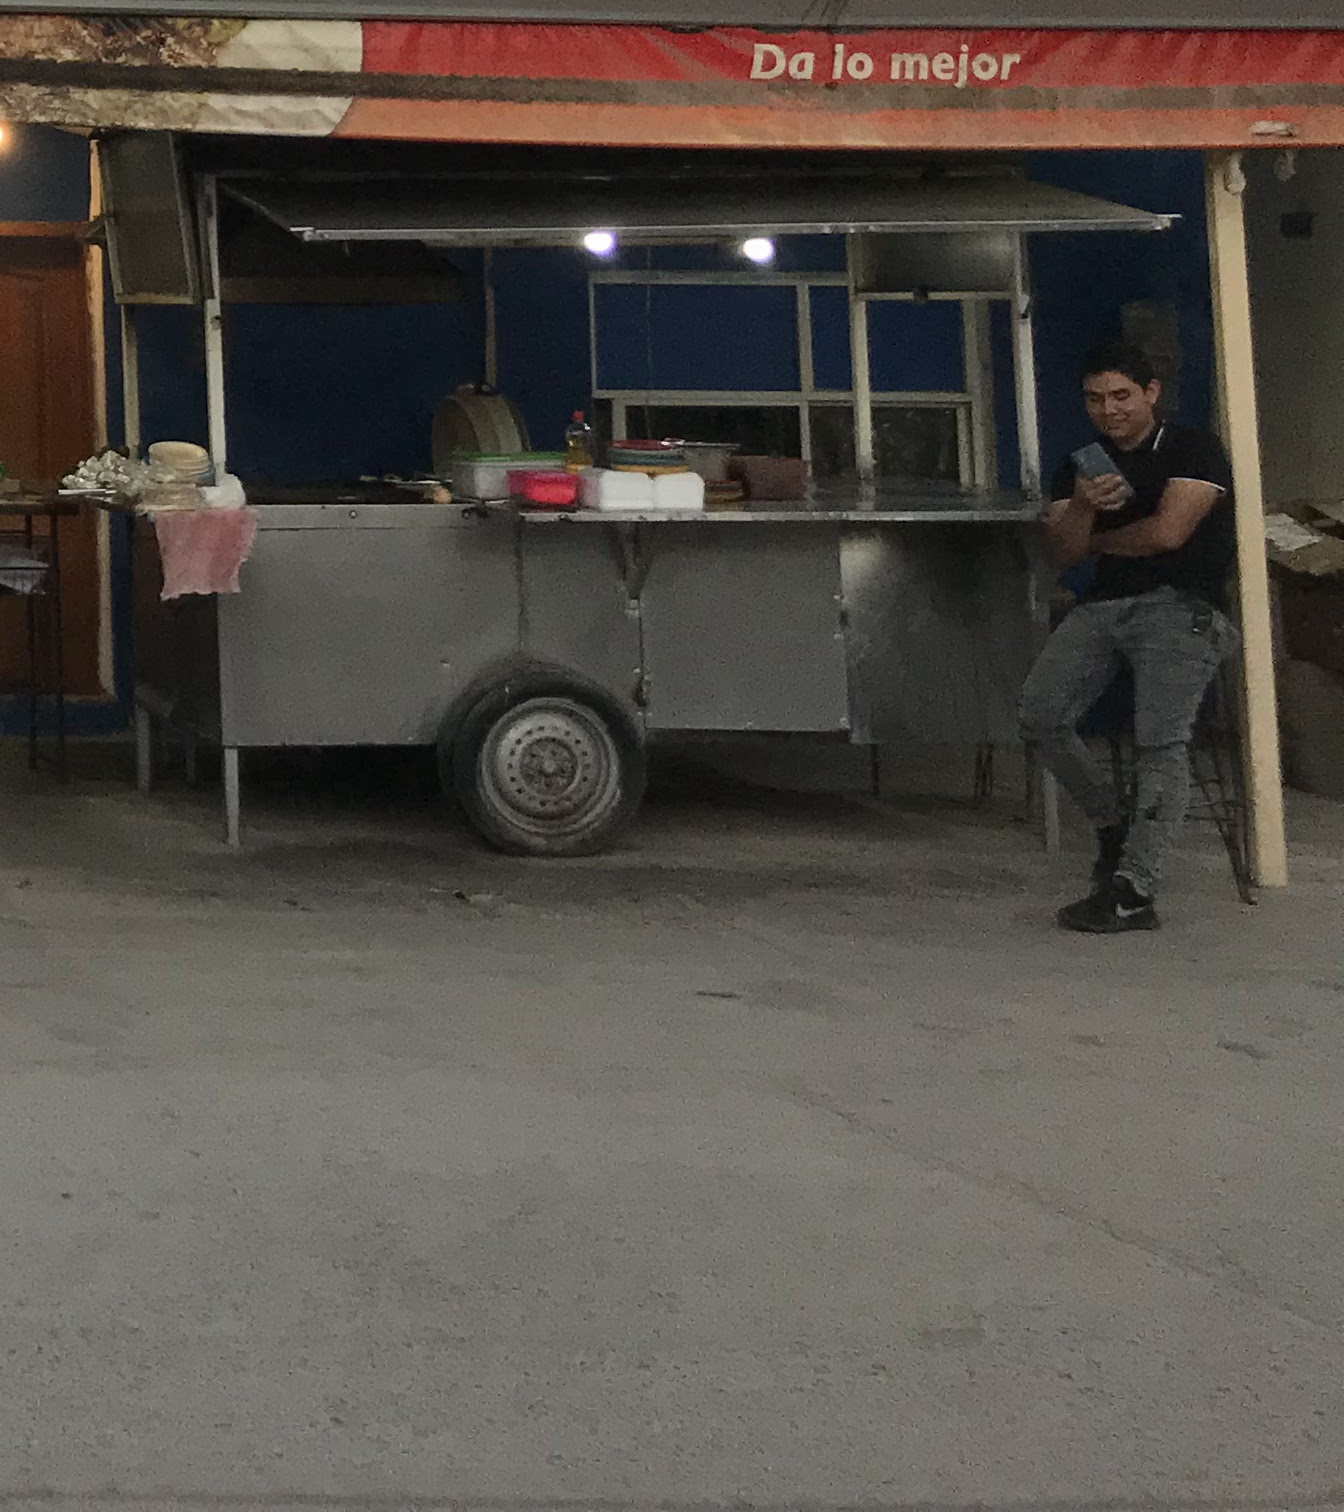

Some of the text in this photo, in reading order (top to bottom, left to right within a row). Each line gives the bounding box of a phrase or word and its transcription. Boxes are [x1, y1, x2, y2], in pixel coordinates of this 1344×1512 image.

[749, 43, 1021, 88] Da lo mejor
